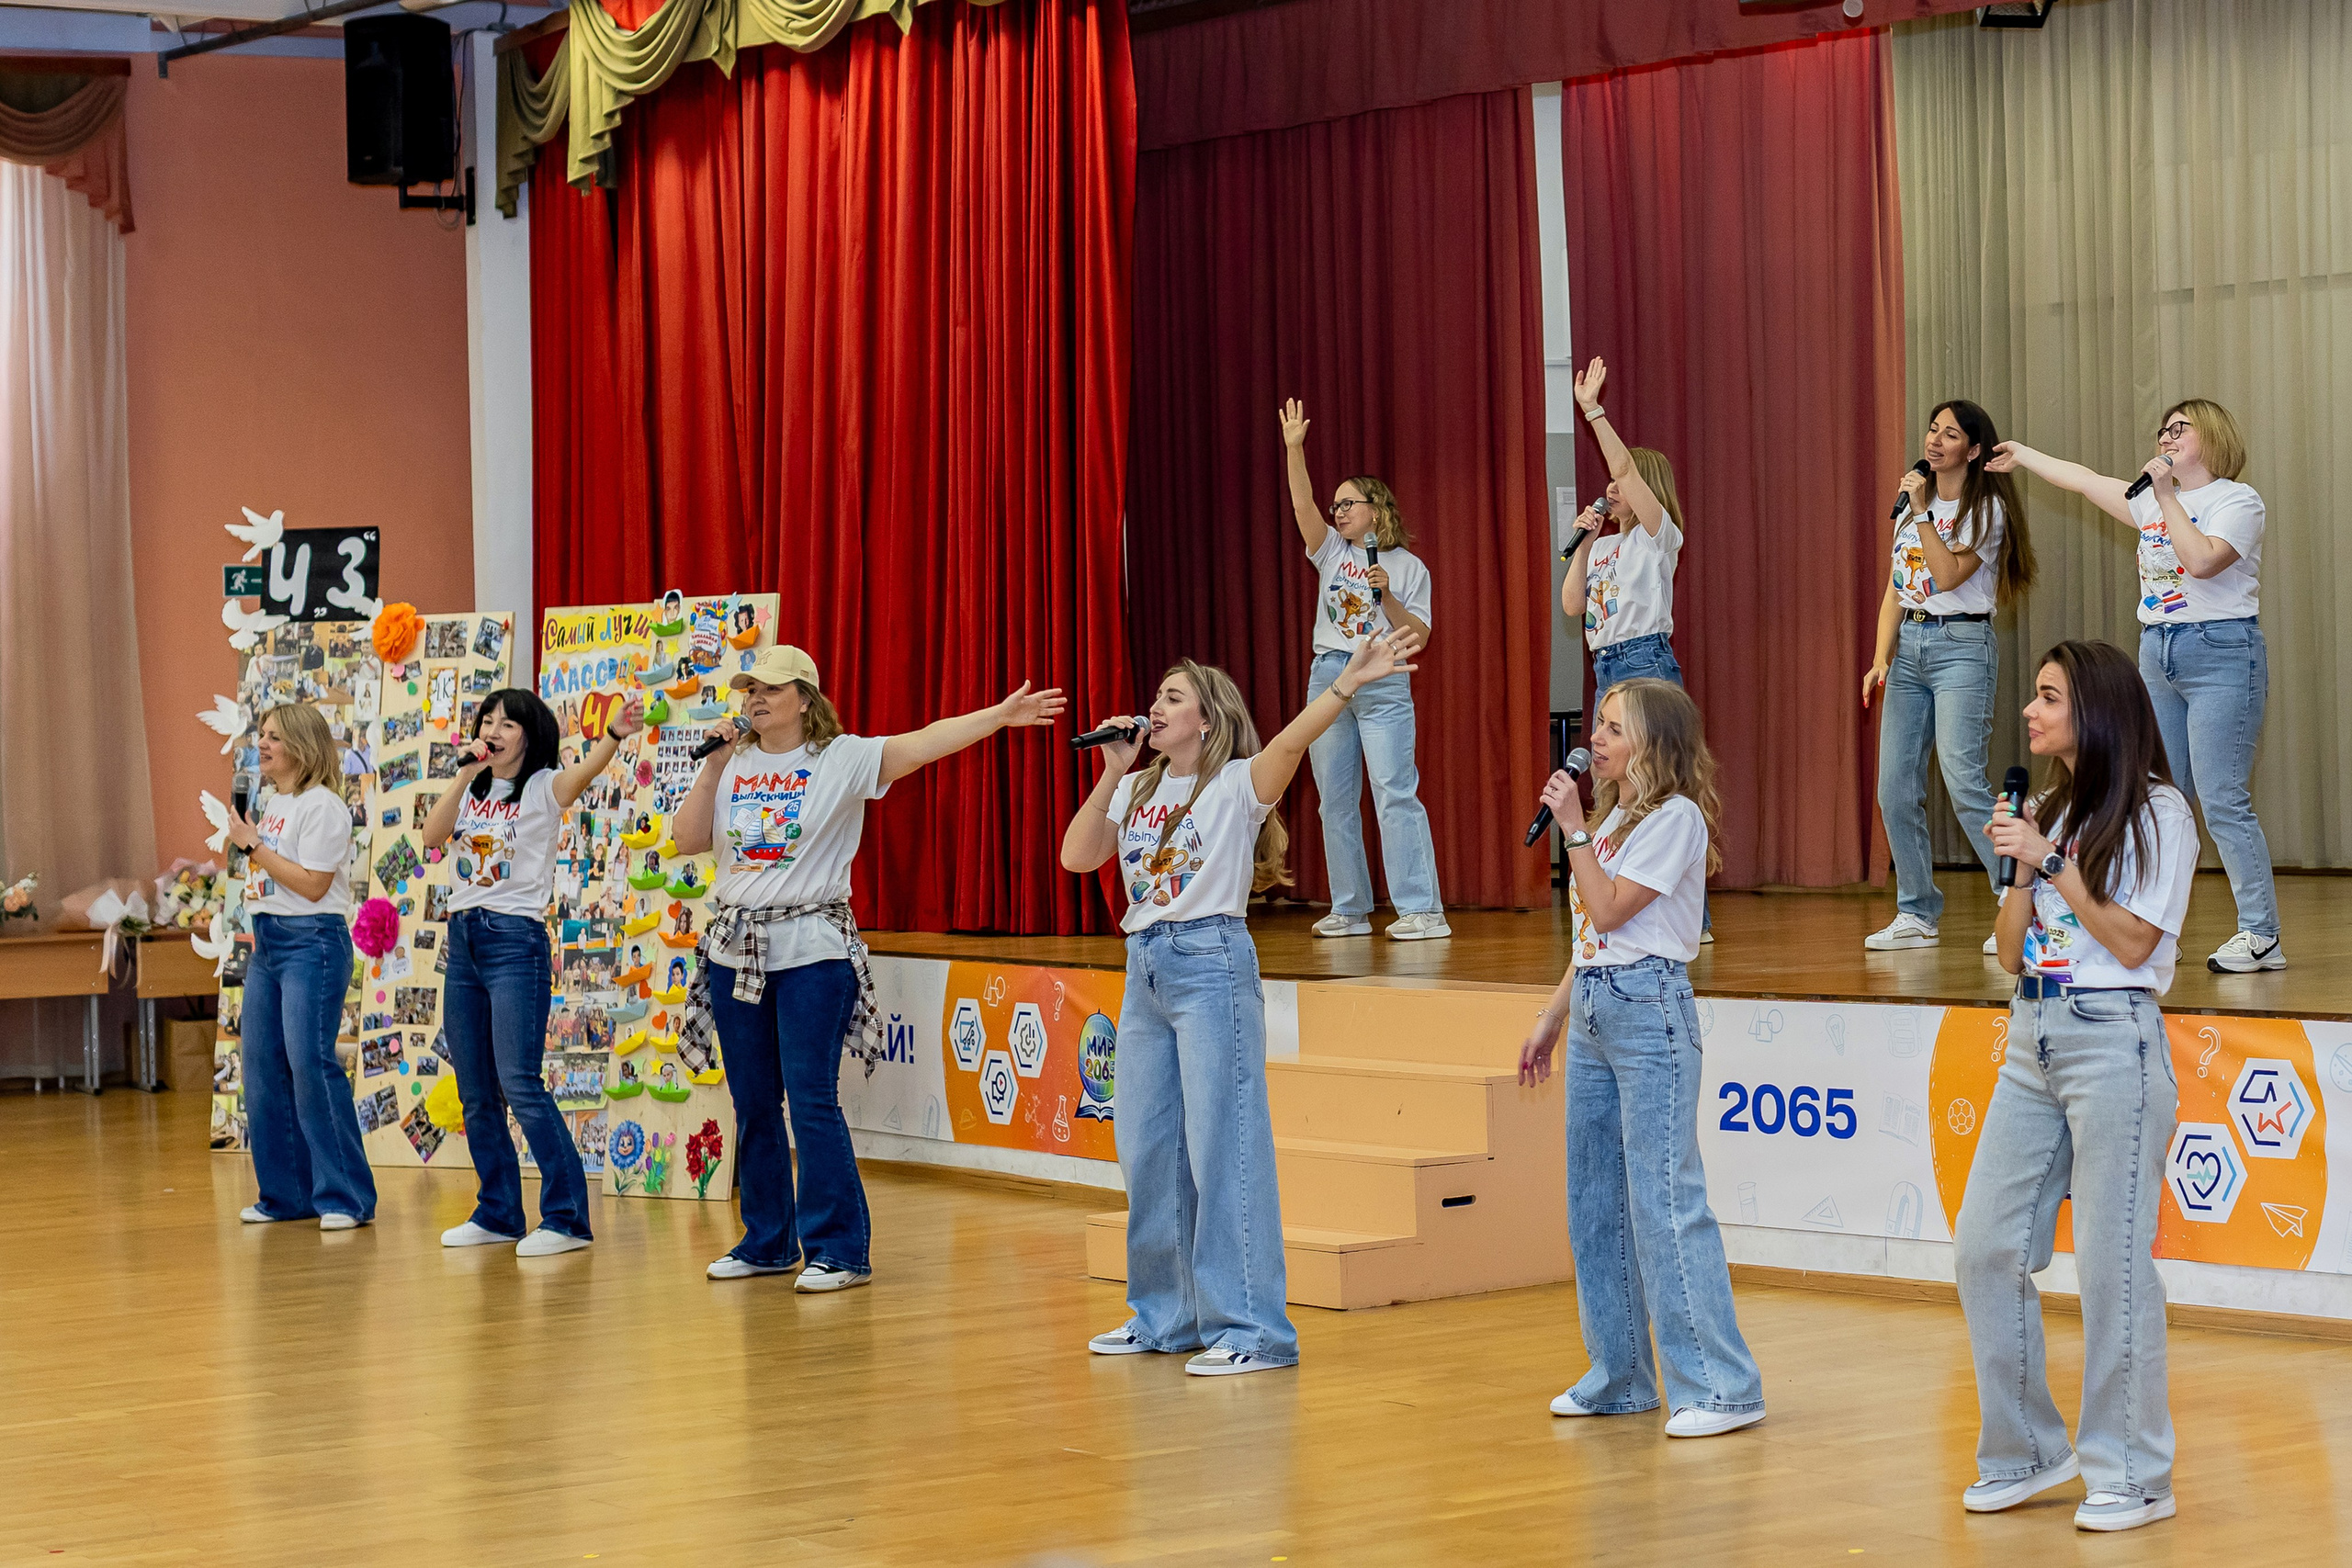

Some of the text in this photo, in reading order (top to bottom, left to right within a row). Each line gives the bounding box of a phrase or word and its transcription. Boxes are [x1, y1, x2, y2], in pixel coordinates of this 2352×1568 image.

[544, 616, 595, 651] Самый
[541, 660, 608, 700] КЛАСС
[733, 772, 808, 793] МАМА
[788, 802, 799, 812] 25
[1086, 1035, 1114, 1058] МИР
[1719, 1081, 1858, 1139] 2065
